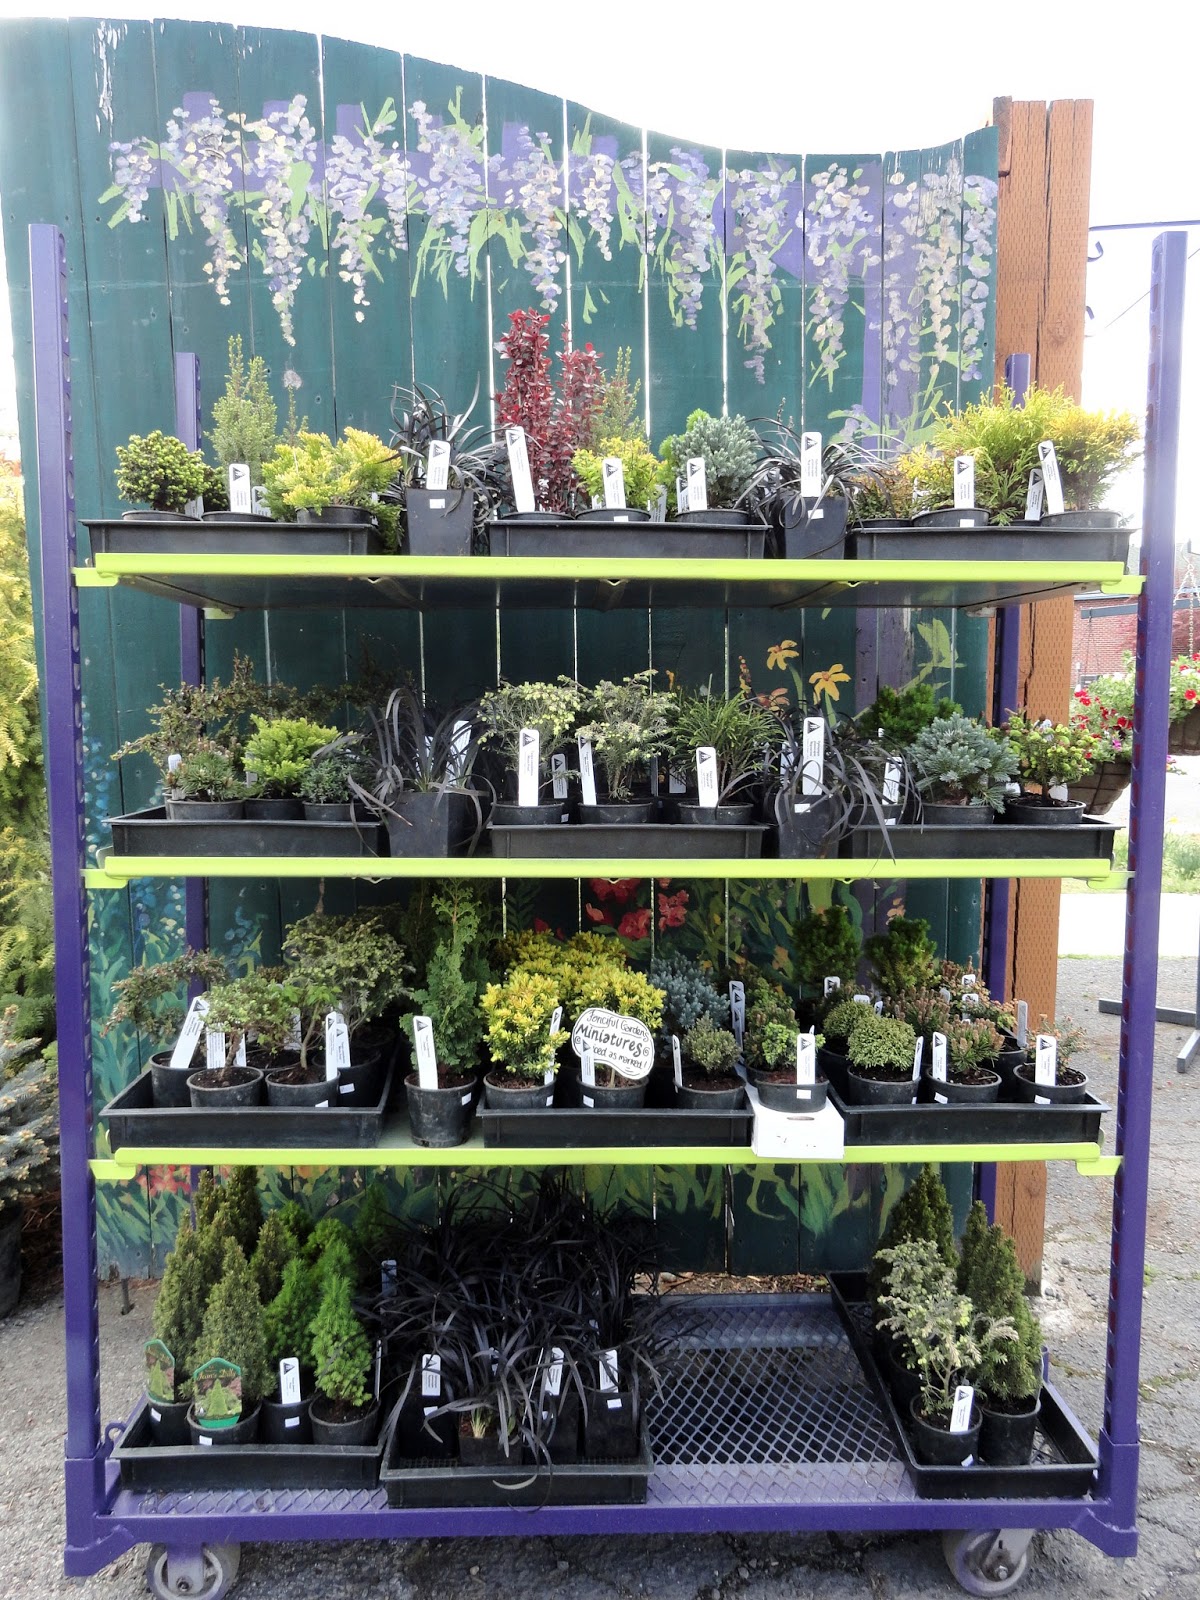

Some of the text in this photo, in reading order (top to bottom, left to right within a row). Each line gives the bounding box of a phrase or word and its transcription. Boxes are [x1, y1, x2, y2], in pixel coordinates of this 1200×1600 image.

[575, 1024, 643, 1057] Miniatures
[621, 1020, 649, 1042] Gardens
[609, 1051, 617, 1060] as
